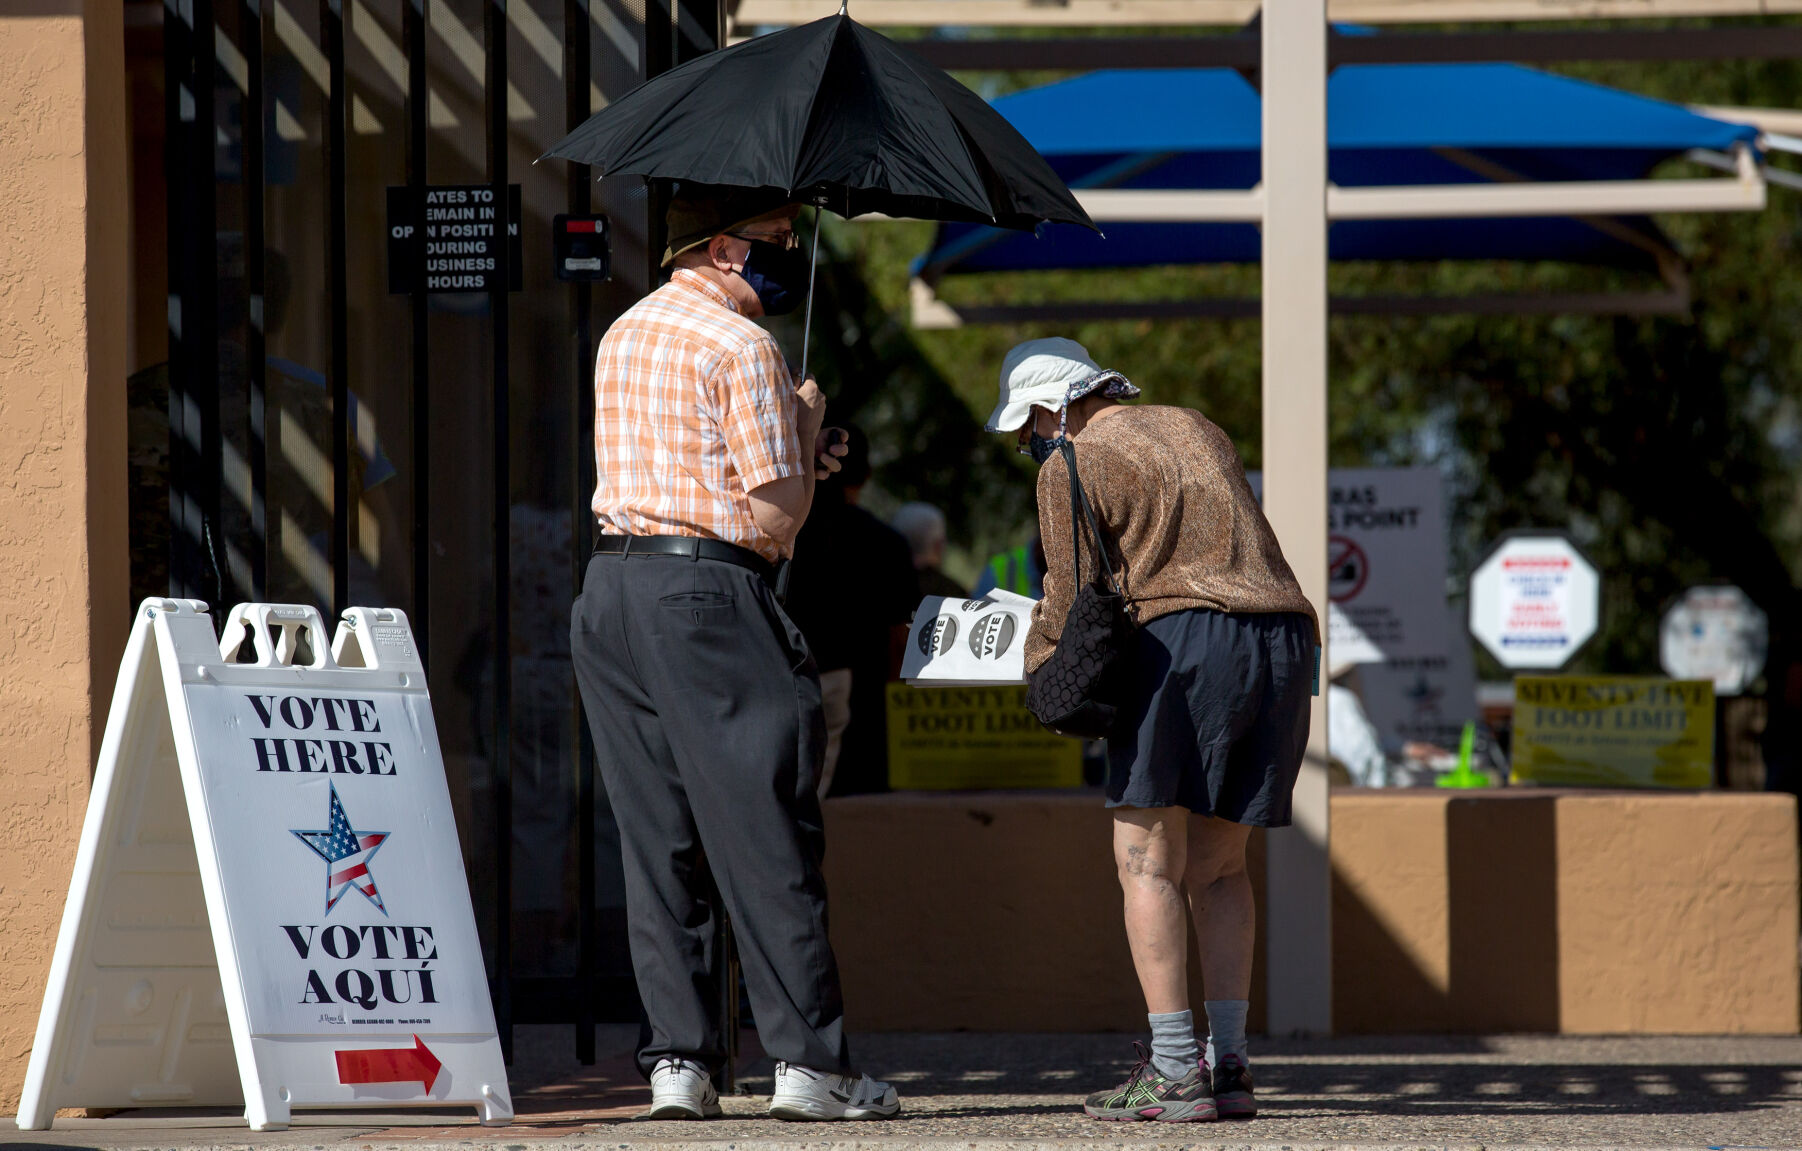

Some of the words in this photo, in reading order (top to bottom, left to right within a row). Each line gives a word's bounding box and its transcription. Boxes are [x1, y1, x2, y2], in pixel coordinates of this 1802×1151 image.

[426, 190, 467, 204] ATES
[471, 189, 494, 203] TO
[426, 207, 475, 221] EMAIN
[479, 206, 495, 220] IN
[391, 224, 436, 239] OPN
[441, 223, 518, 238] POSITIN
[426, 257, 495, 272] USINESS
[428, 275, 485, 289] HOURS
[1343, 506, 1421, 529] POINT
[931, 619, 946, 653] VOTE
[984, 616, 1001, 656] VOTE
[244, 694, 382, 733] VOTE
[907, 713, 976, 732] FOOT
[1534, 707, 1605, 728] FOOT
[1614, 708, 1693, 731] LIMIT
[249, 737, 397, 776] HERE
[279, 924, 439, 960] VOTE
[298, 961, 440, 1011] AQUÍ
